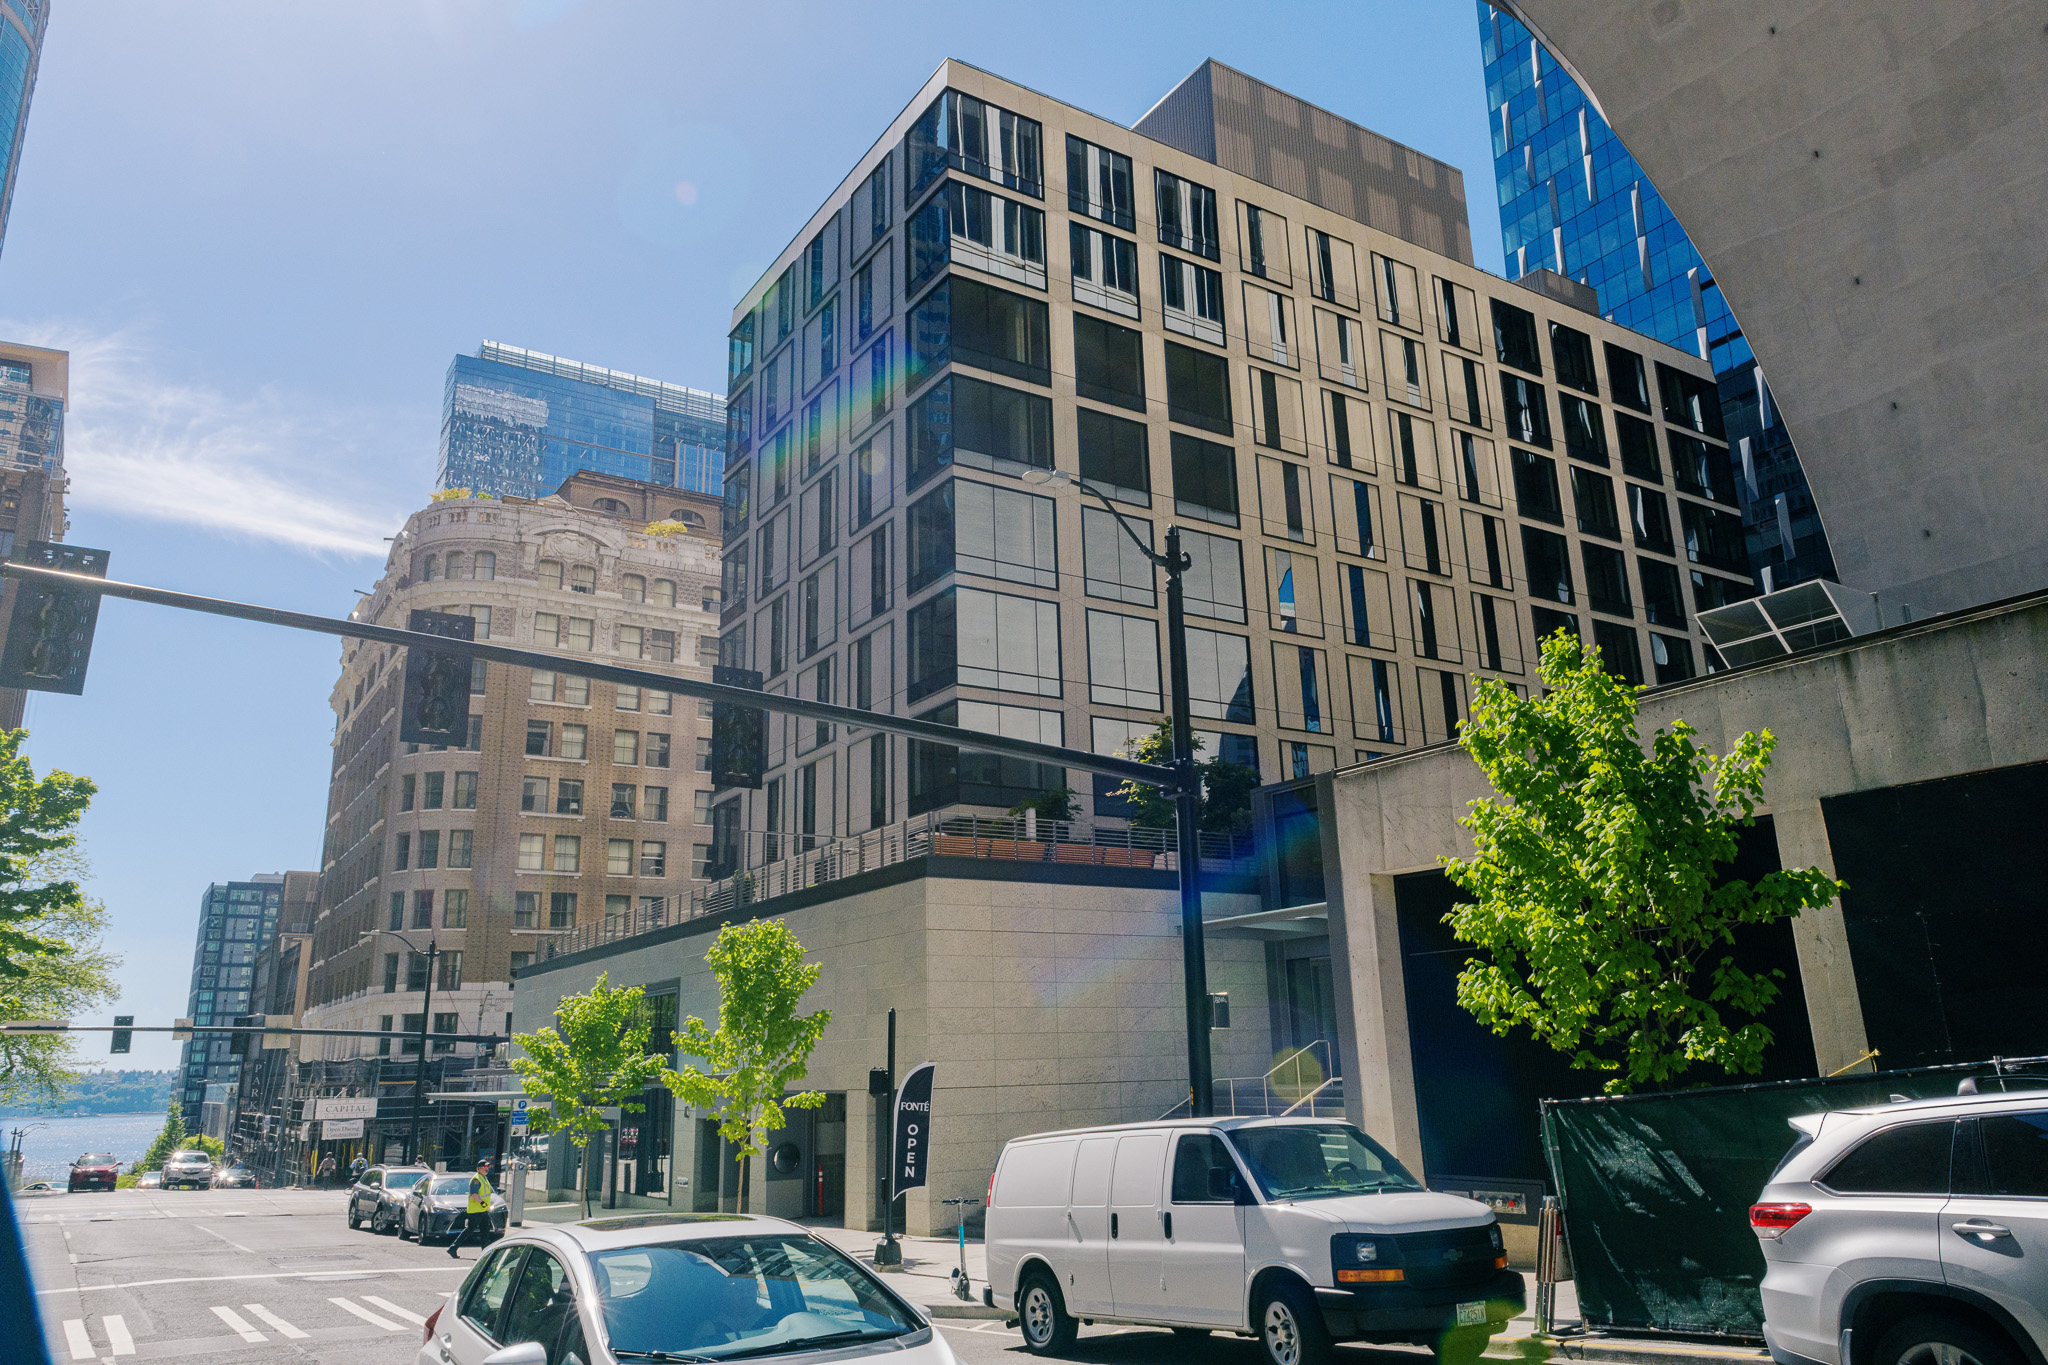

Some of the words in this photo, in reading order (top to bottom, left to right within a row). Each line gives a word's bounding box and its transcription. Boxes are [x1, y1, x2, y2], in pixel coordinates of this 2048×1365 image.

[250, 1064, 262, 1110] PARK
[325, 1104, 368, 1113] CAPITAL
[900, 1100, 930, 1112] FONTÉ
[904, 1124, 919, 1178] OPEN
